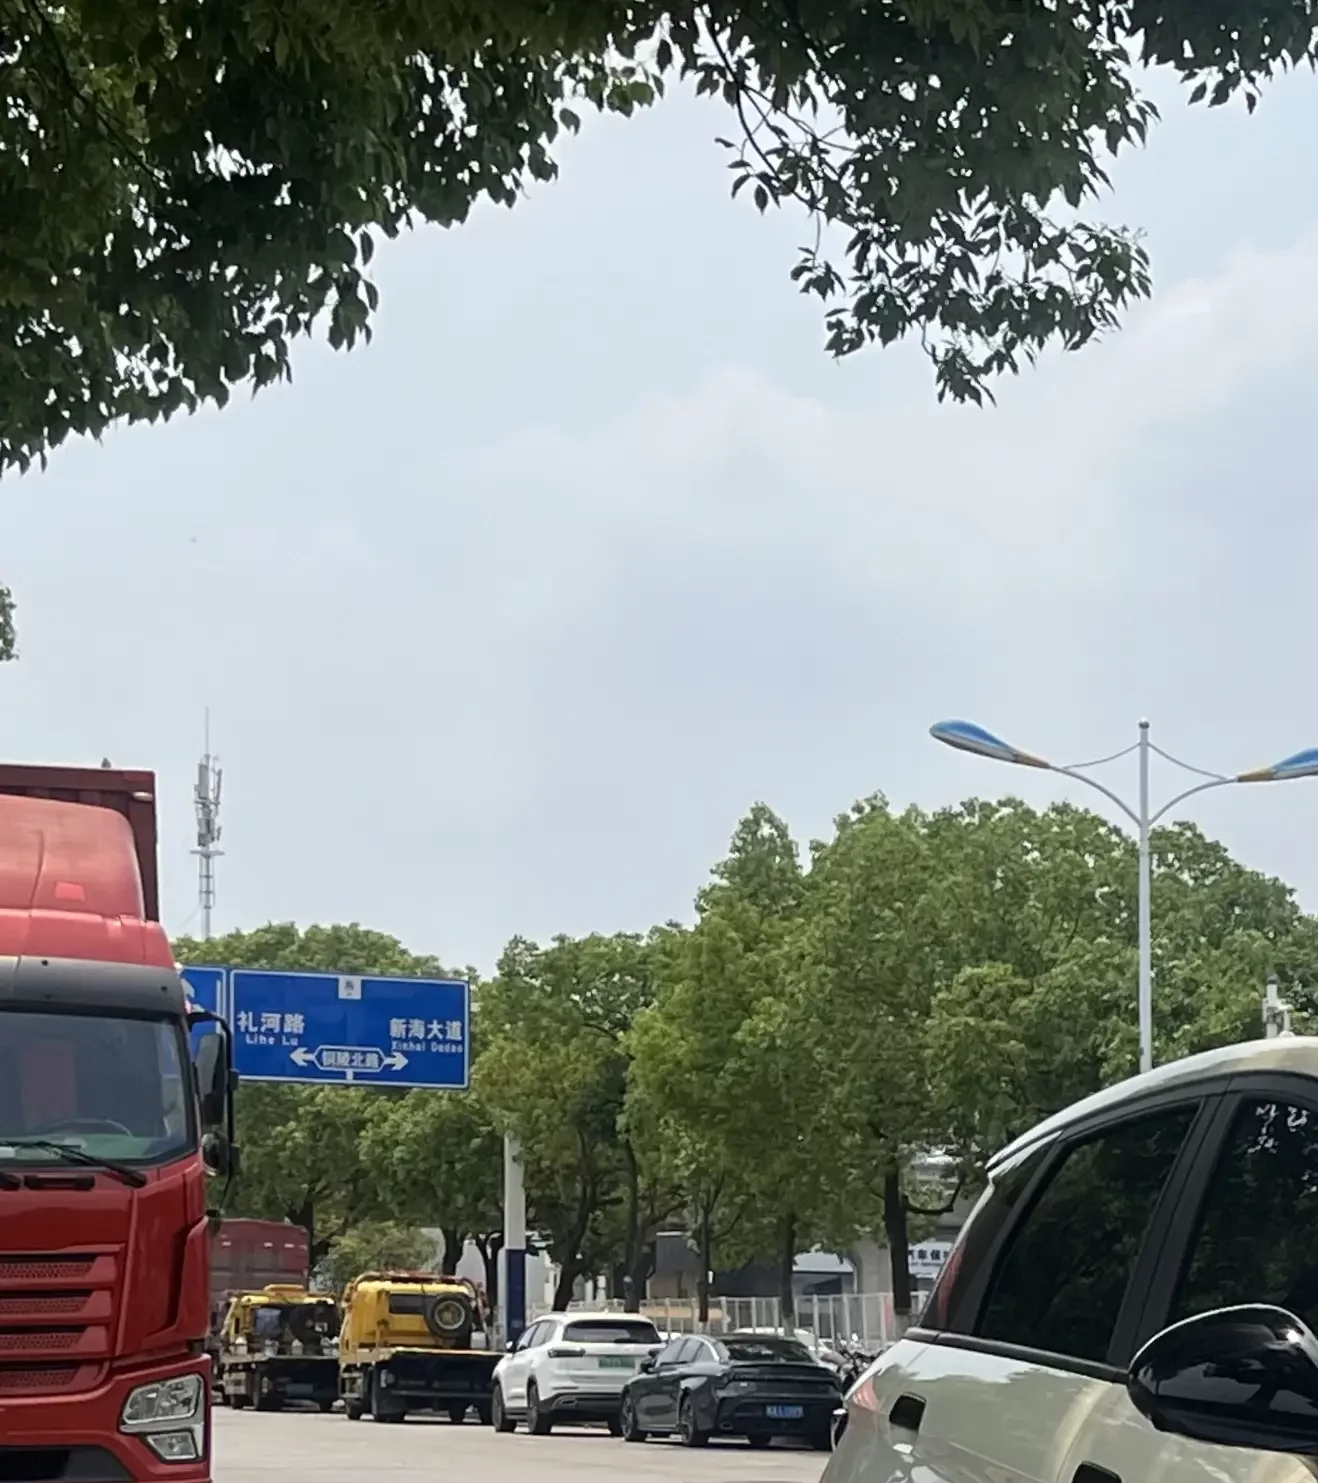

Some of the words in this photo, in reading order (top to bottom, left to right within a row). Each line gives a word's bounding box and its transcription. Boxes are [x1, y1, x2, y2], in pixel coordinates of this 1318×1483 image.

[237, 1010, 305, 1034] 礼河路
[390, 1018, 463, 1040] 新海大道
[282, 1035, 299, 1046] Lu
